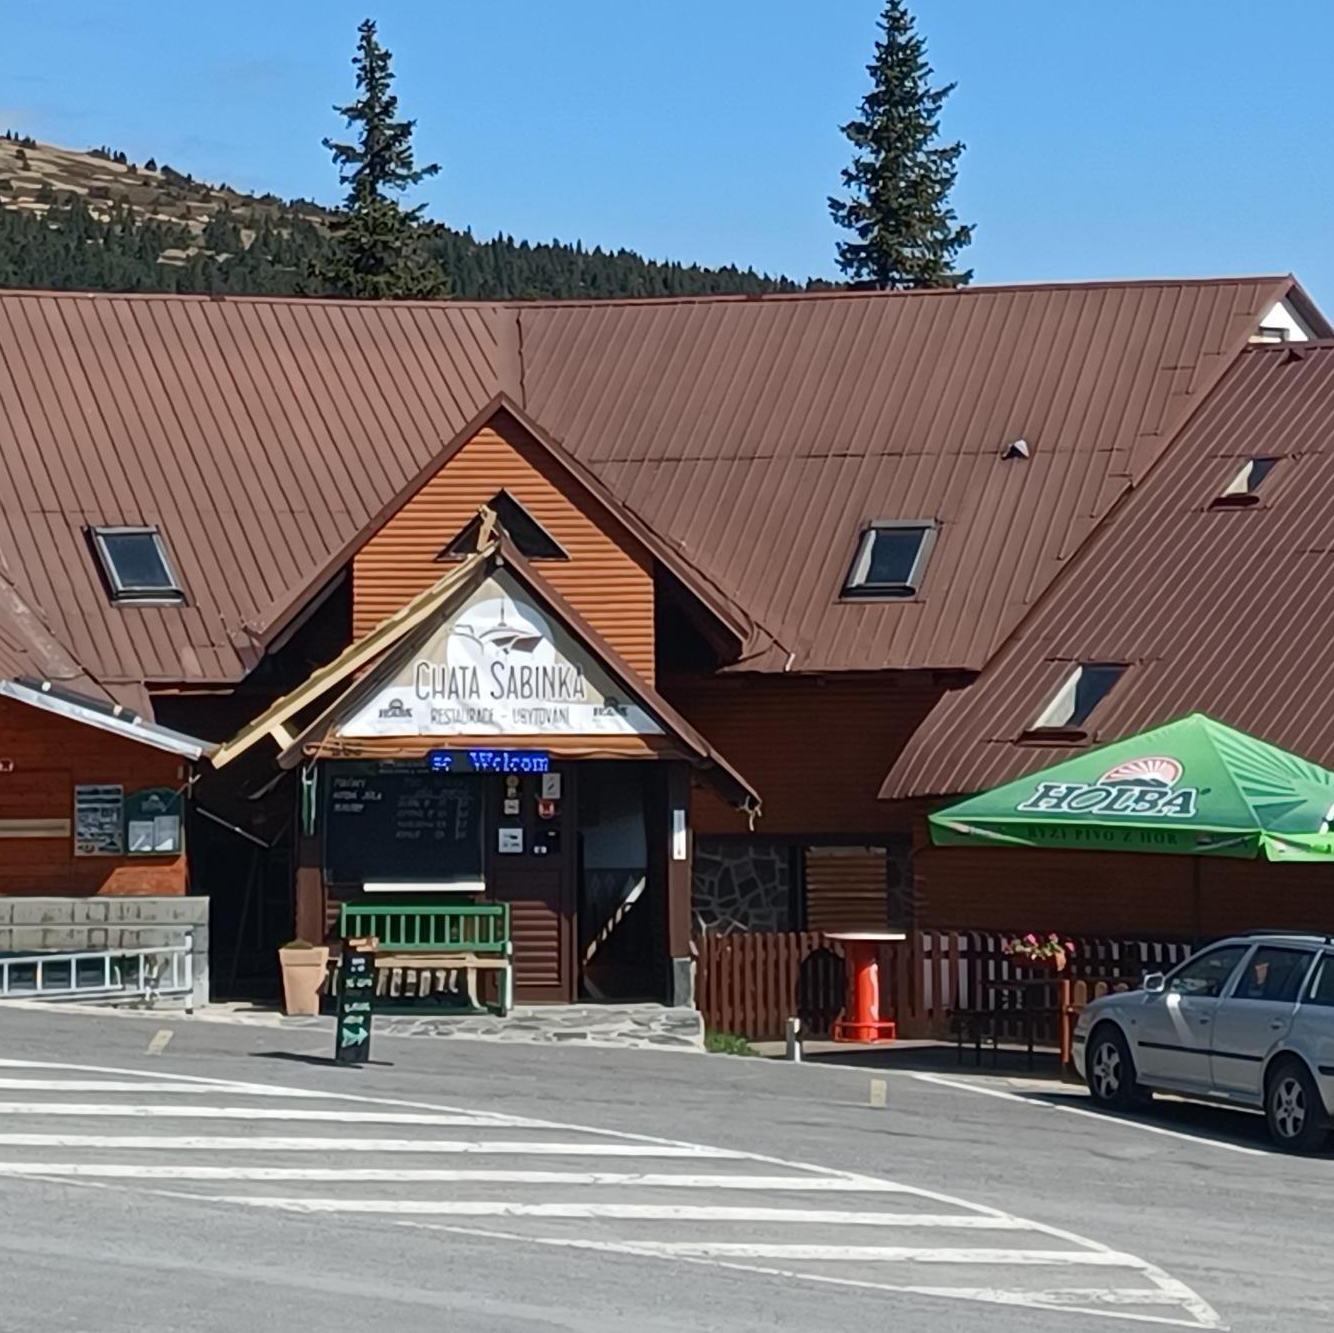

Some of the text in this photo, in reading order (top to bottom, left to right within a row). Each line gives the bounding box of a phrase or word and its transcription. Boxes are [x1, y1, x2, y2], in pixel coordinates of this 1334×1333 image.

[415, 661, 585, 700] CHATA SABINKA
[1017, 782, 1198, 816] HOLBA
[1075, 829, 1115, 842] PIVO
[1123, 831, 1133, 843] Z
[1140, 832, 1178, 844] HOR
